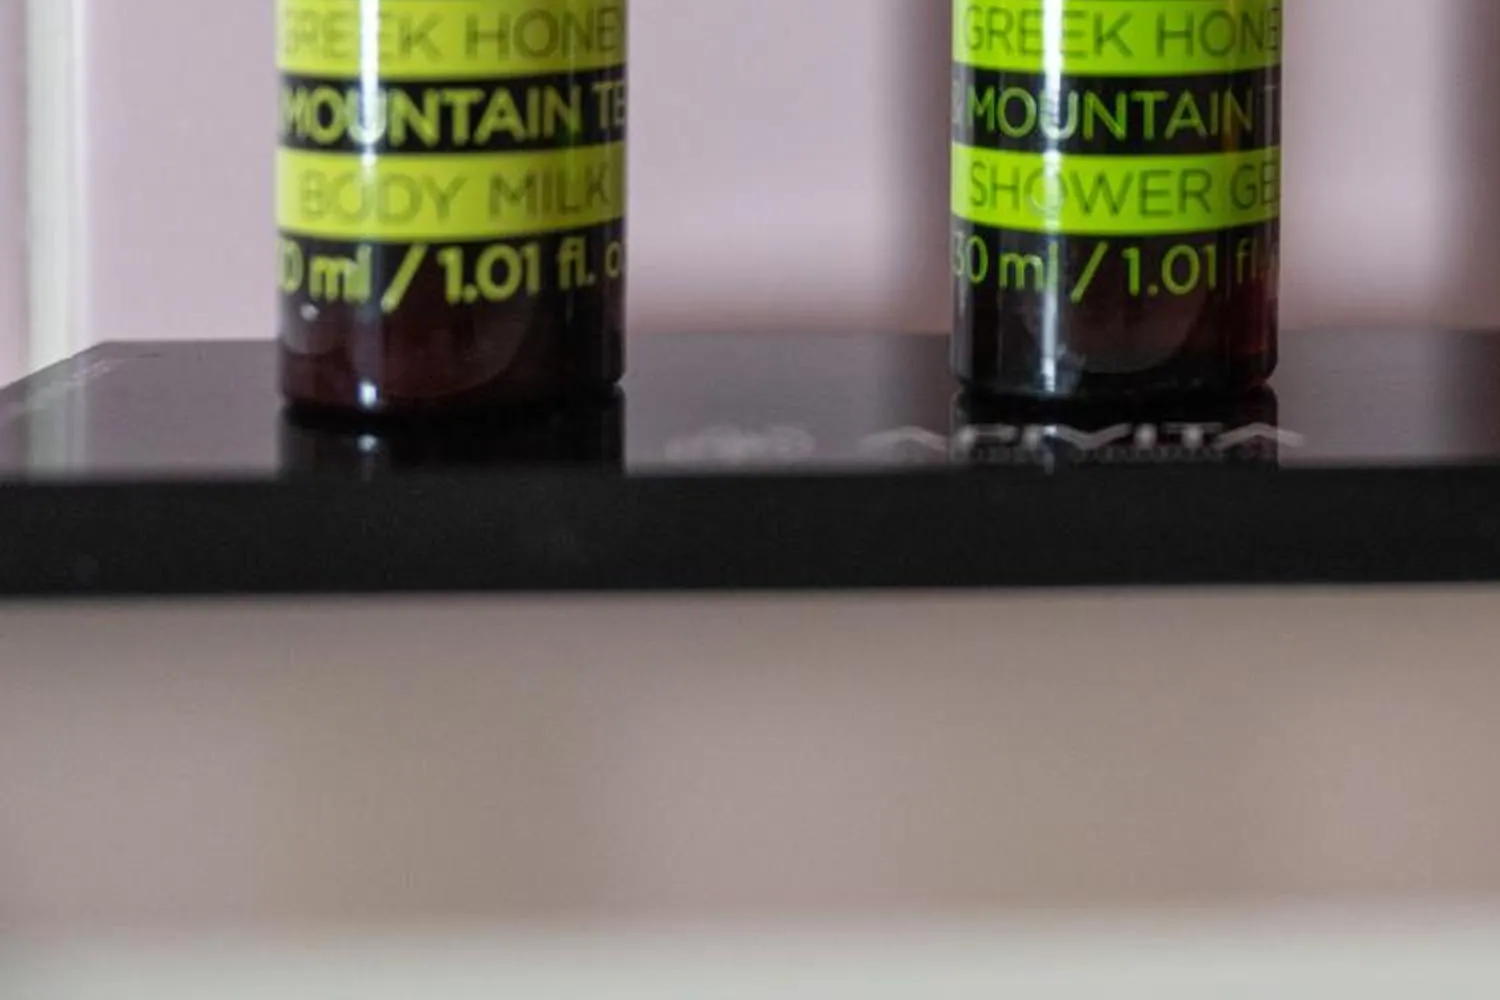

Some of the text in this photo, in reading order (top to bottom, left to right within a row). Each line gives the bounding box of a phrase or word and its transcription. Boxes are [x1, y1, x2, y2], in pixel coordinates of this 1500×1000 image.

[964, 5, 1134, 61] GREEK
[282, 85, 582, 146] MOUNTAIN
[963, 85, 1254, 140] MOUNTAIN
[302, 160, 612, 224] BODY MILK
[969, 161, 1213, 220] SHOWER
[309, 243, 374, 301] ml
[437, 242, 541, 304] 1.01
[998, 241, 1058, 291] ml
[1122, 244, 1218, 297] 1.01
